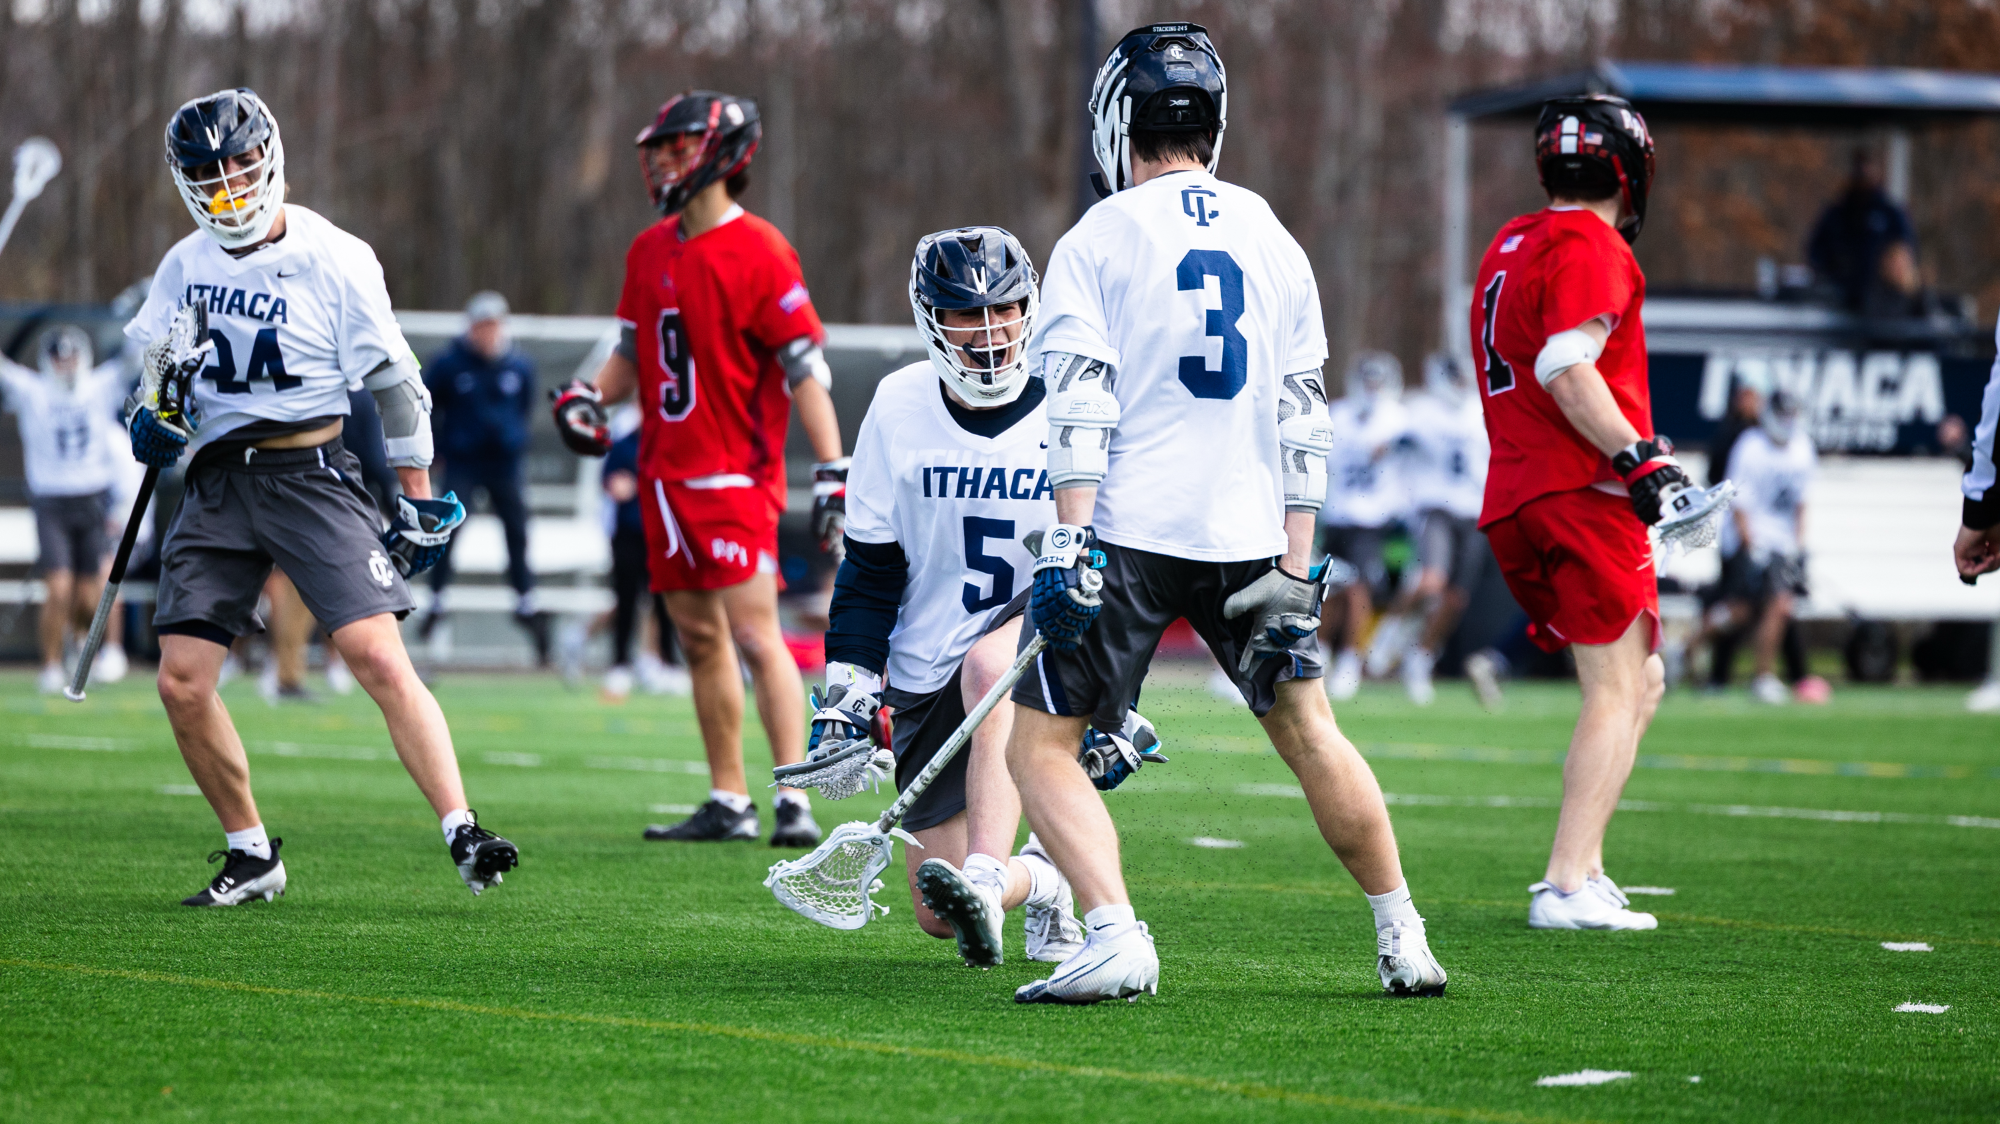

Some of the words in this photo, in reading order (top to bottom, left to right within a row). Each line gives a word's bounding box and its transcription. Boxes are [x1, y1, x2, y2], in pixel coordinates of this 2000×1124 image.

[186, 284, 288, 324] ITHACA
[1176, 249, 1248, 400] 3
[1482, 270, 1516, 397] 1
[656, 307, 697, 422] 9
[1068, 400, 1110, 416] STX
[1308, 427, 1333, 443] ST
[923, 466, 1055, 500] ITHACA
[962, 516, 1015, 614] 5
[1034, 555, 1065, 567] ERIK
